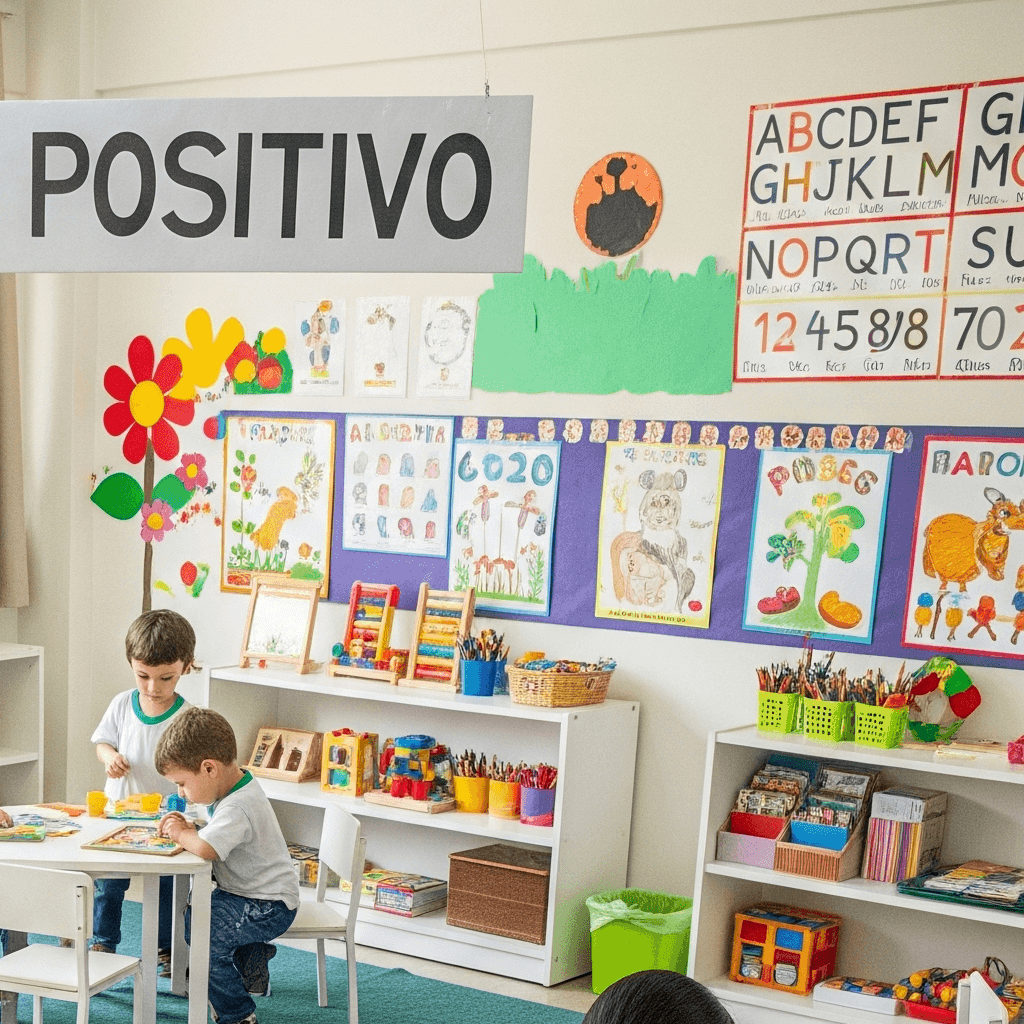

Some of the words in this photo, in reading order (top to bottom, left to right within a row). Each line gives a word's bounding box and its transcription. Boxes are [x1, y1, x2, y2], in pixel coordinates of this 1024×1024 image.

[755, 97, 949, 155] ABCDEF
[981, 91, 1024, 136] G
[32, 131, 493, 241] POSITIVO
[750, 150, 955, 205] GHJKLM
[746, 228, 945, 281] NOPQRT
